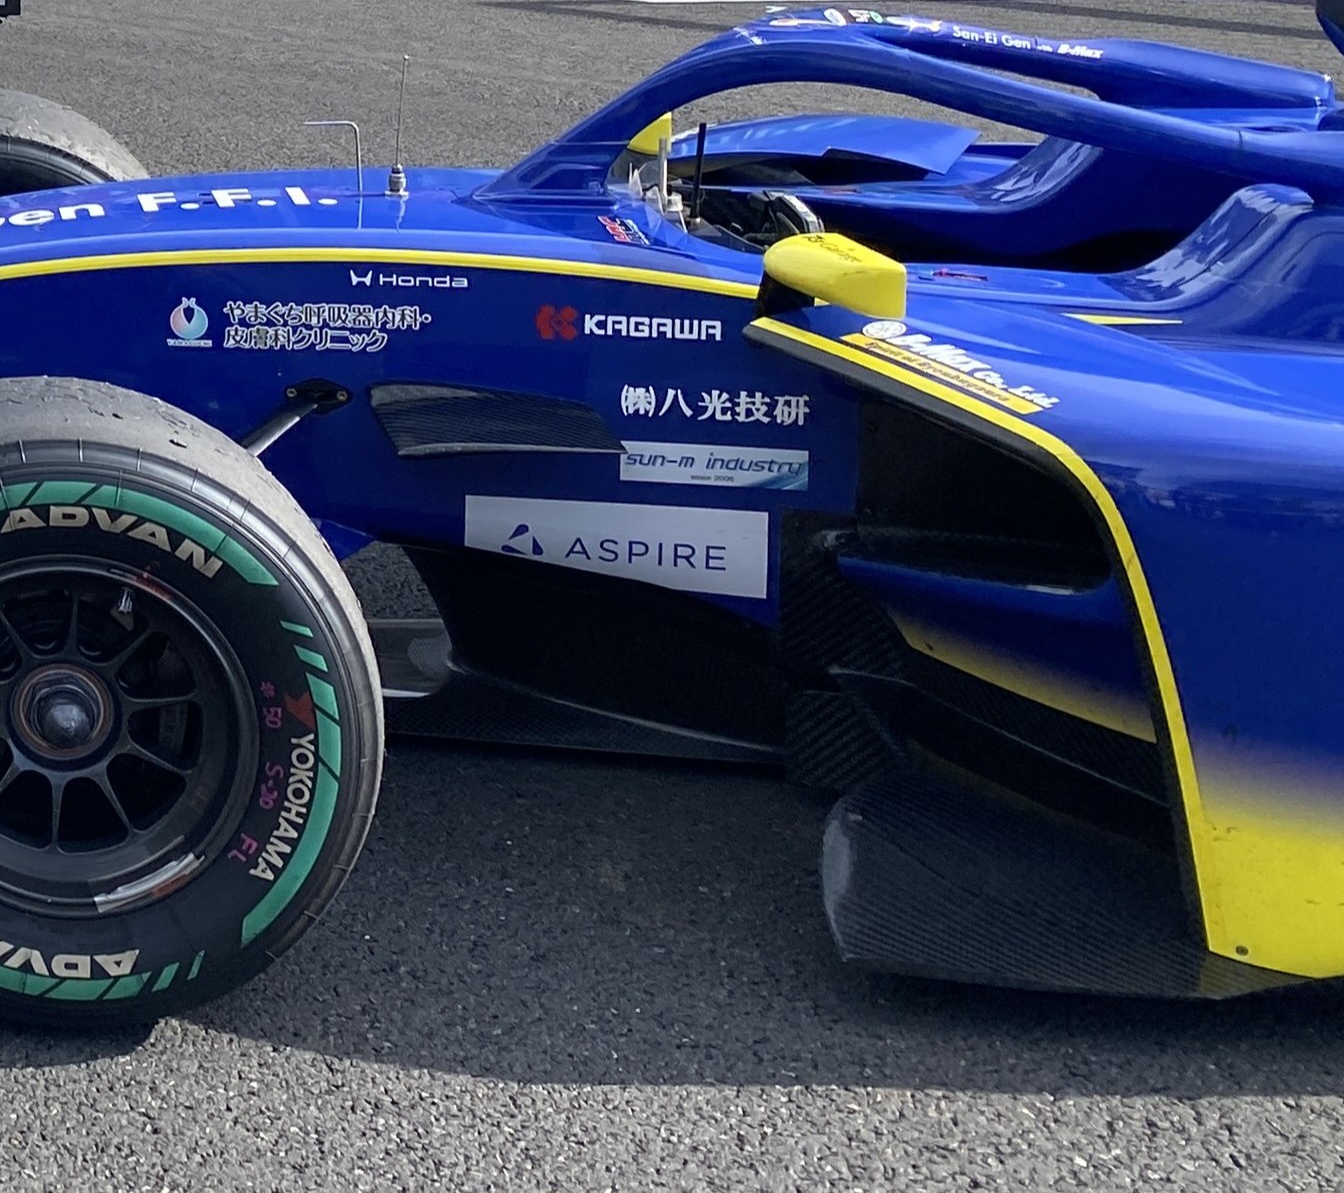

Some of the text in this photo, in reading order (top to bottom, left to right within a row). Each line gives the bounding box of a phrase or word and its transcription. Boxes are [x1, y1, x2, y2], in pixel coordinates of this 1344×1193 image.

[952, 24, 998, 45] San-Ei
[1001, 34, 1032, 51] Gen
[136, 186, 339, 213] F.F.I.
[379, 273, 469, 289] Honda
[584, 314, 722, 342] KAGAWA
[625, 452, 803, 477] sun-m industry
[0, 505, 224, 580] ADVAN
[564, 537, 728, 572] ASPIRE
[248, 732, 317, 884] YOKOHAMA
